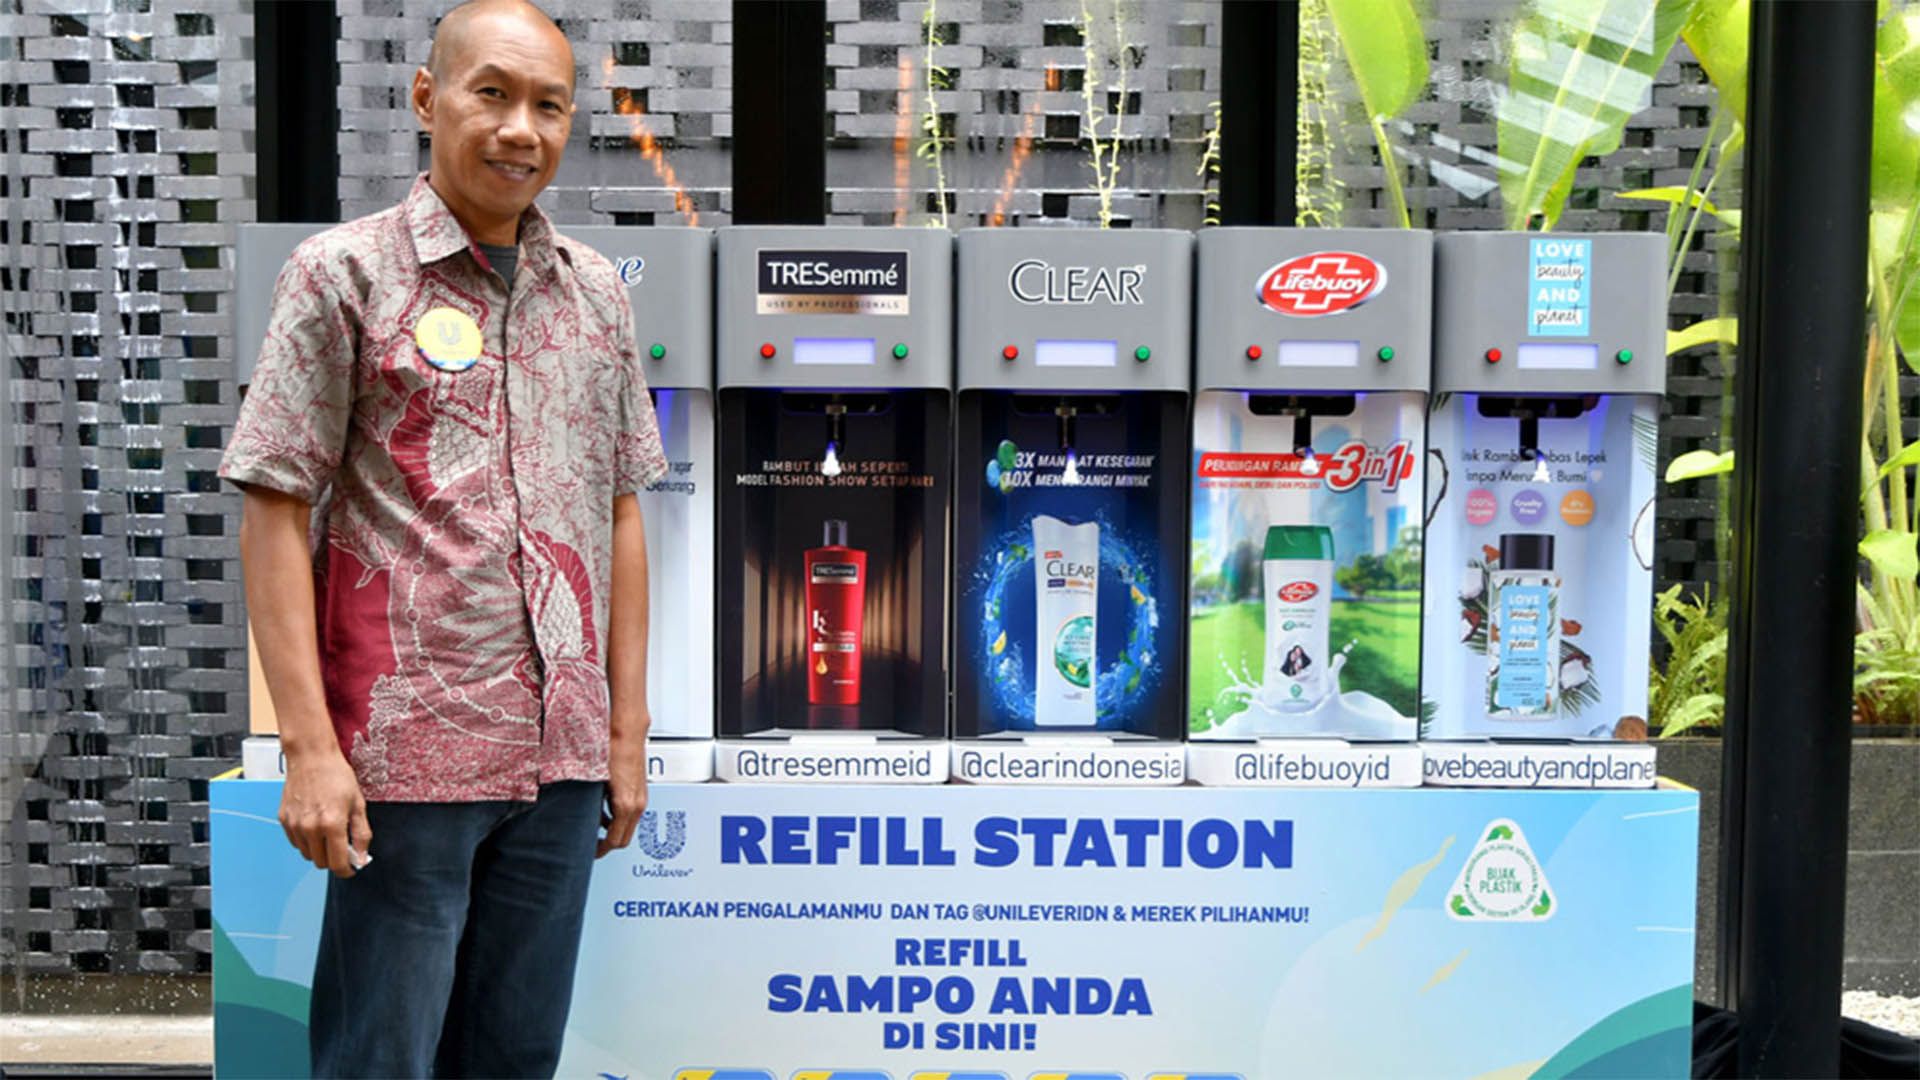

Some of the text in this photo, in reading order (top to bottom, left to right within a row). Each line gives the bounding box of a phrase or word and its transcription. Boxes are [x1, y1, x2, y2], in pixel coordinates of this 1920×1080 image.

[1536, 243, 1584, 257] LOVE
[766, 261, 898, 286] TRESemmé
[1271, 272, 1372, 294] Lifebuoy
[1536, 258, 1585, 289] beauty
[814, 301, 899, 309] PROFESSIONALS
[1537, 288, 1580, 302] AND
[1536, 302, 1586, 333] planet
[828, 475, 868, 486] SHOW
[1557, 470, 1587, 482] Bumi
[1046, 559, 1094, 578] CLEAR
[737, 749, 931, 778] @tresemmeid
[961, 750, 1181, 779] @clearindonesia
[1235, 752, 1391, 788] @lifebuoyid
[720, 815, 1294, 869] REFILL STATION
[632, 864, 693, 878] Unilever
[1486, 867, 1516, 880] BIJAK
[1479, 880, 1522, 893] PLASTIK
[613, 900, 1310, 923] CERITAKAN PENGALAMANMU DAN TAG @UNILEVERIDN & MEREK PILIHANMU!
[895, 938, 1027, 966] REFILL
[767, 974, 1153, 1015] SAMPO ANDA
[883, 1022, 1037, 1051] DI SINI!
